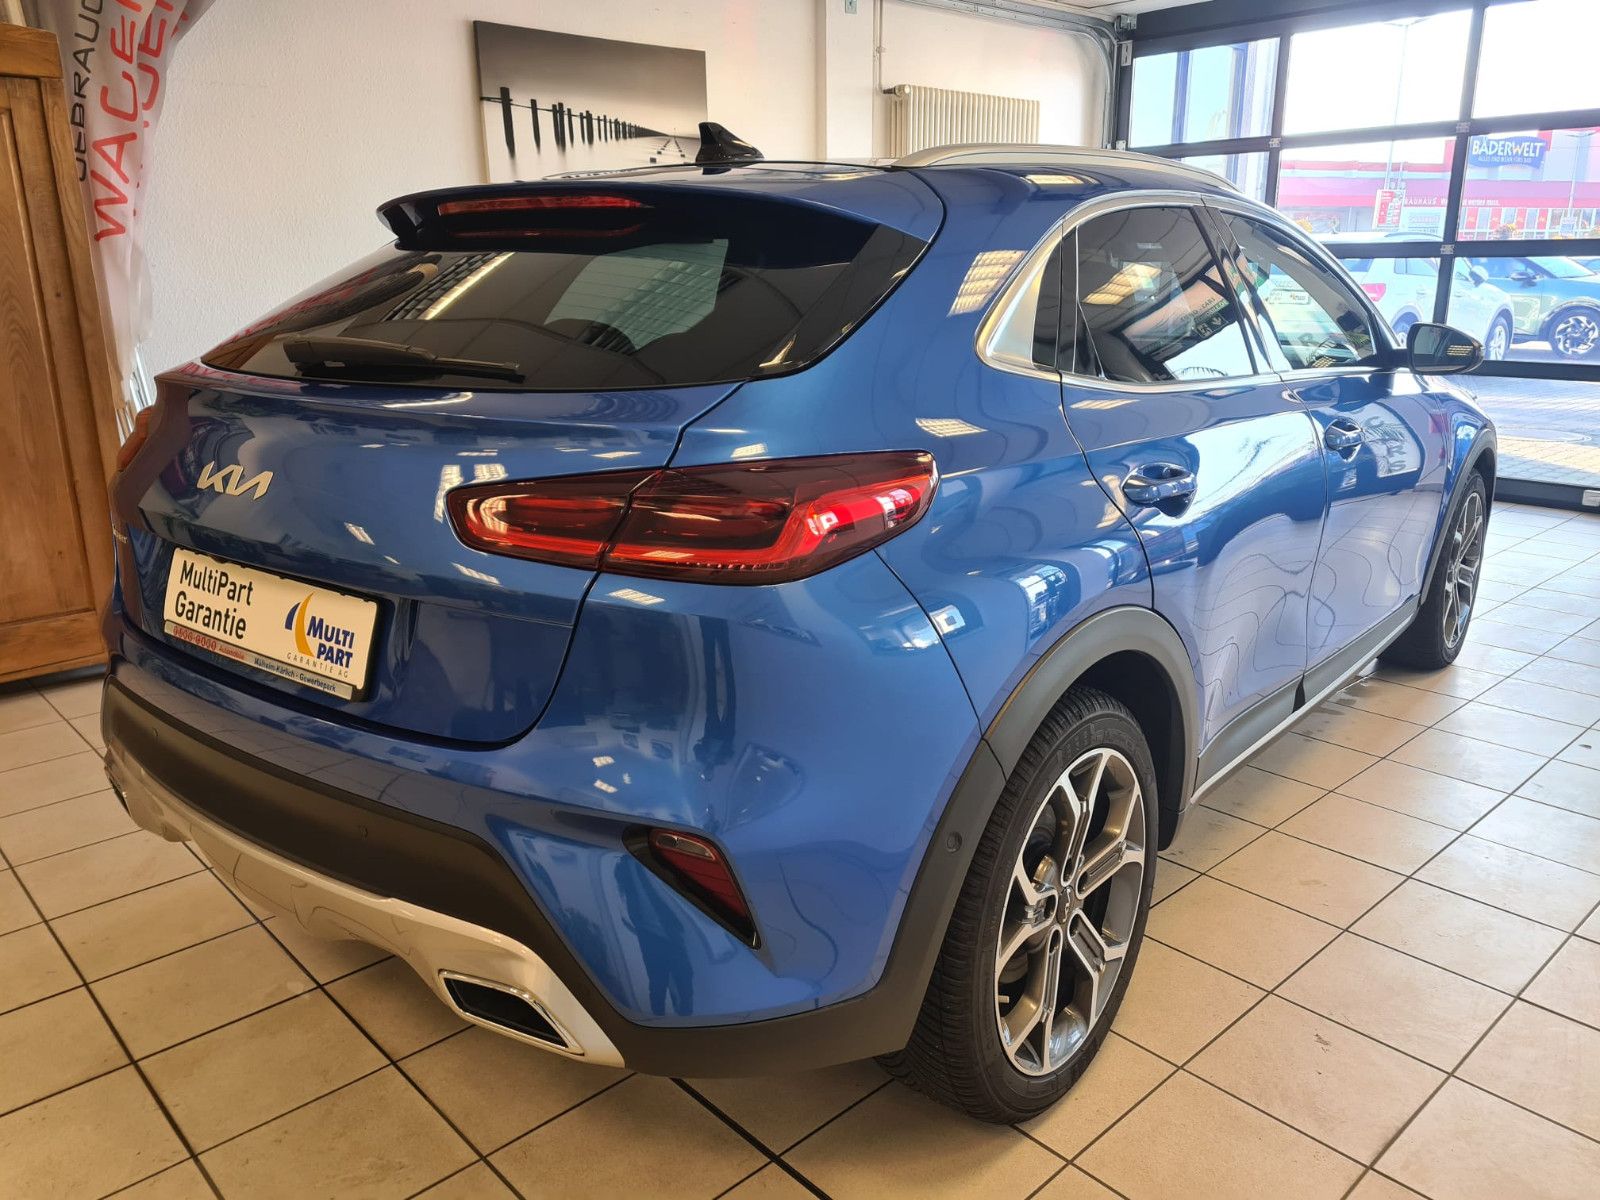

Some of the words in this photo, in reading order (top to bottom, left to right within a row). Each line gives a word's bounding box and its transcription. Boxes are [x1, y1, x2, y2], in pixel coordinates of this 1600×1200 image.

[196, 460, 274, 500] KIA
[179, 559, 254, 606] MultiPart
[174, 591, 247, 639] Garantie
[307, 615, 355, 649] MULTI
[286, 652, 334, 674] GARANTIE
[338, 670, 349, 679] AG
[316, 643, 353, 669] PART
